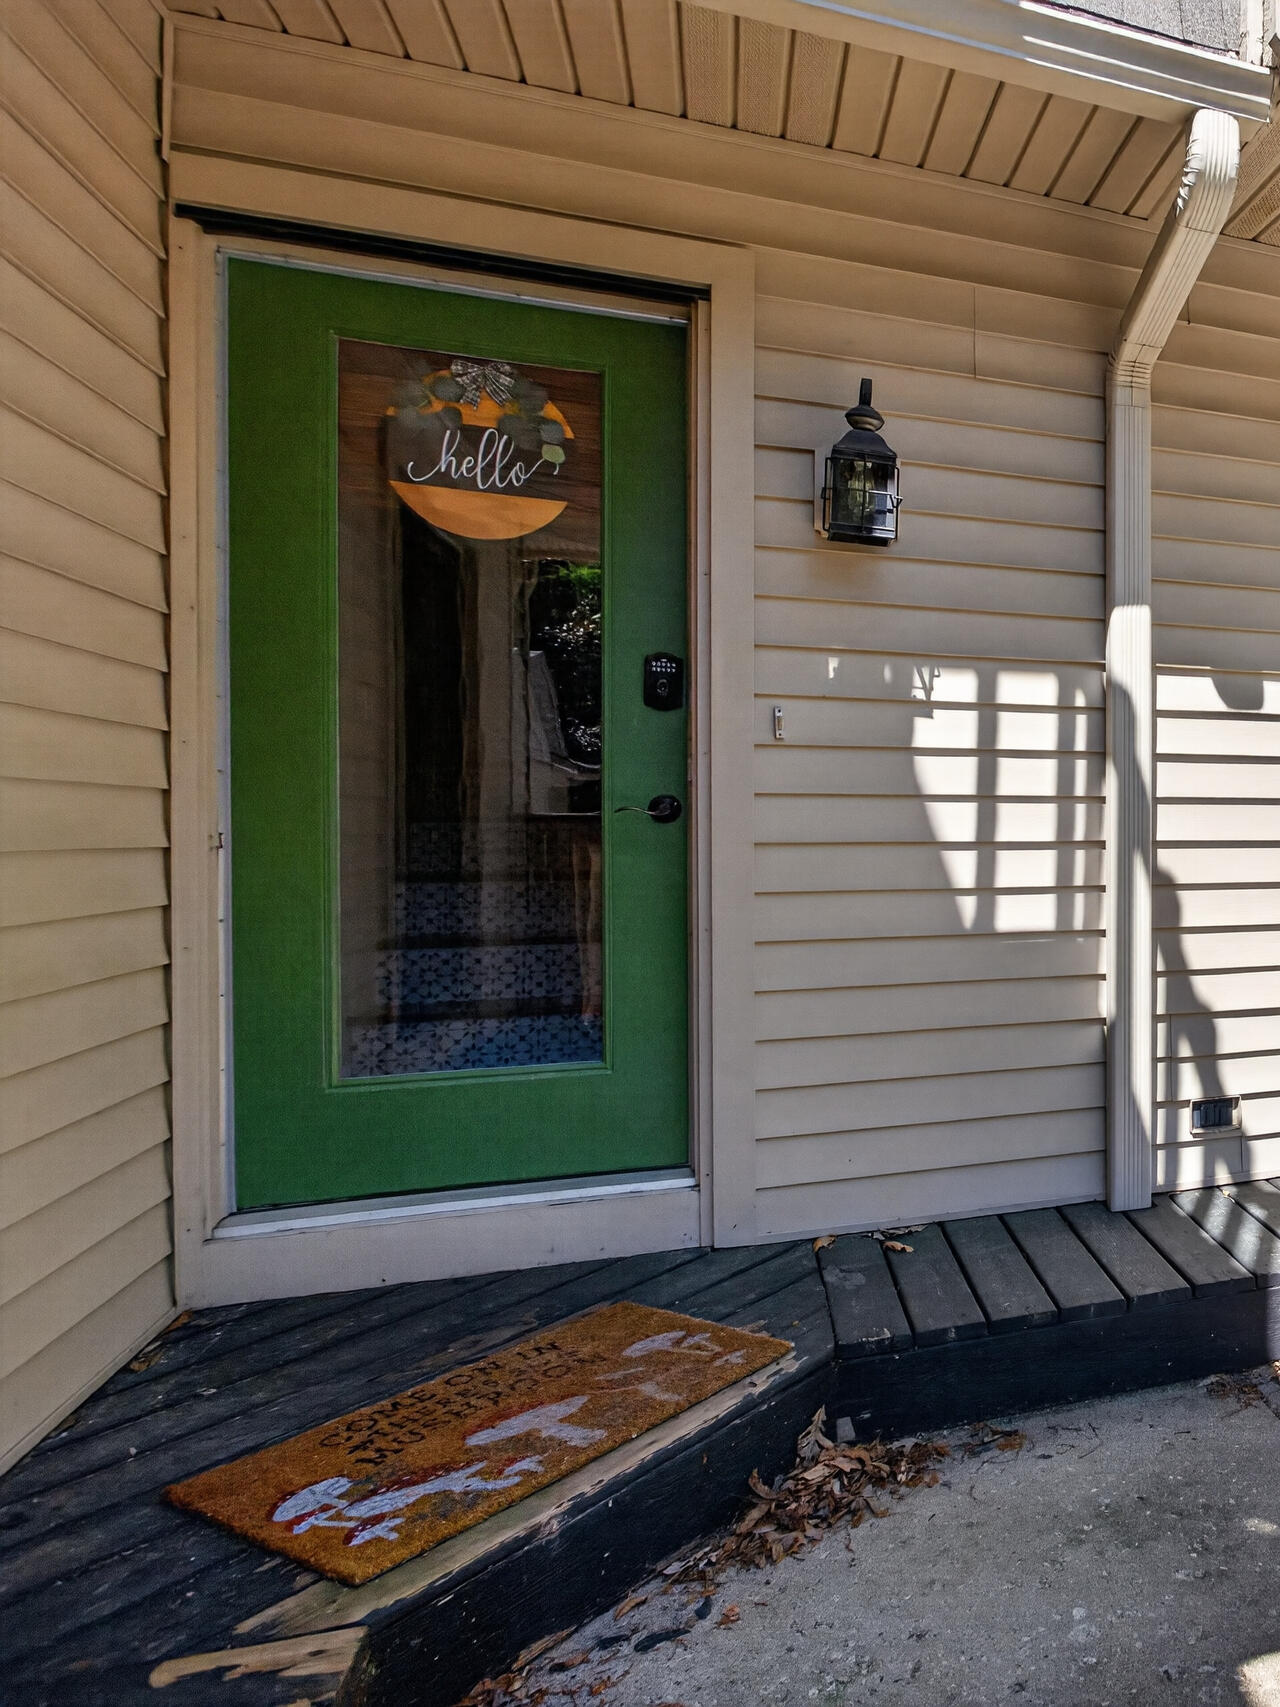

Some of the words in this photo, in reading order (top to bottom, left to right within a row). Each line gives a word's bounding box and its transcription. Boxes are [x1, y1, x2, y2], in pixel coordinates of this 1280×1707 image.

[407, 428, 558, 489] hello
[319, 1390, 437, 1446] COME
[444, 1361, 503, 1386] ON
[516, 1341, 561, 1360] IN
